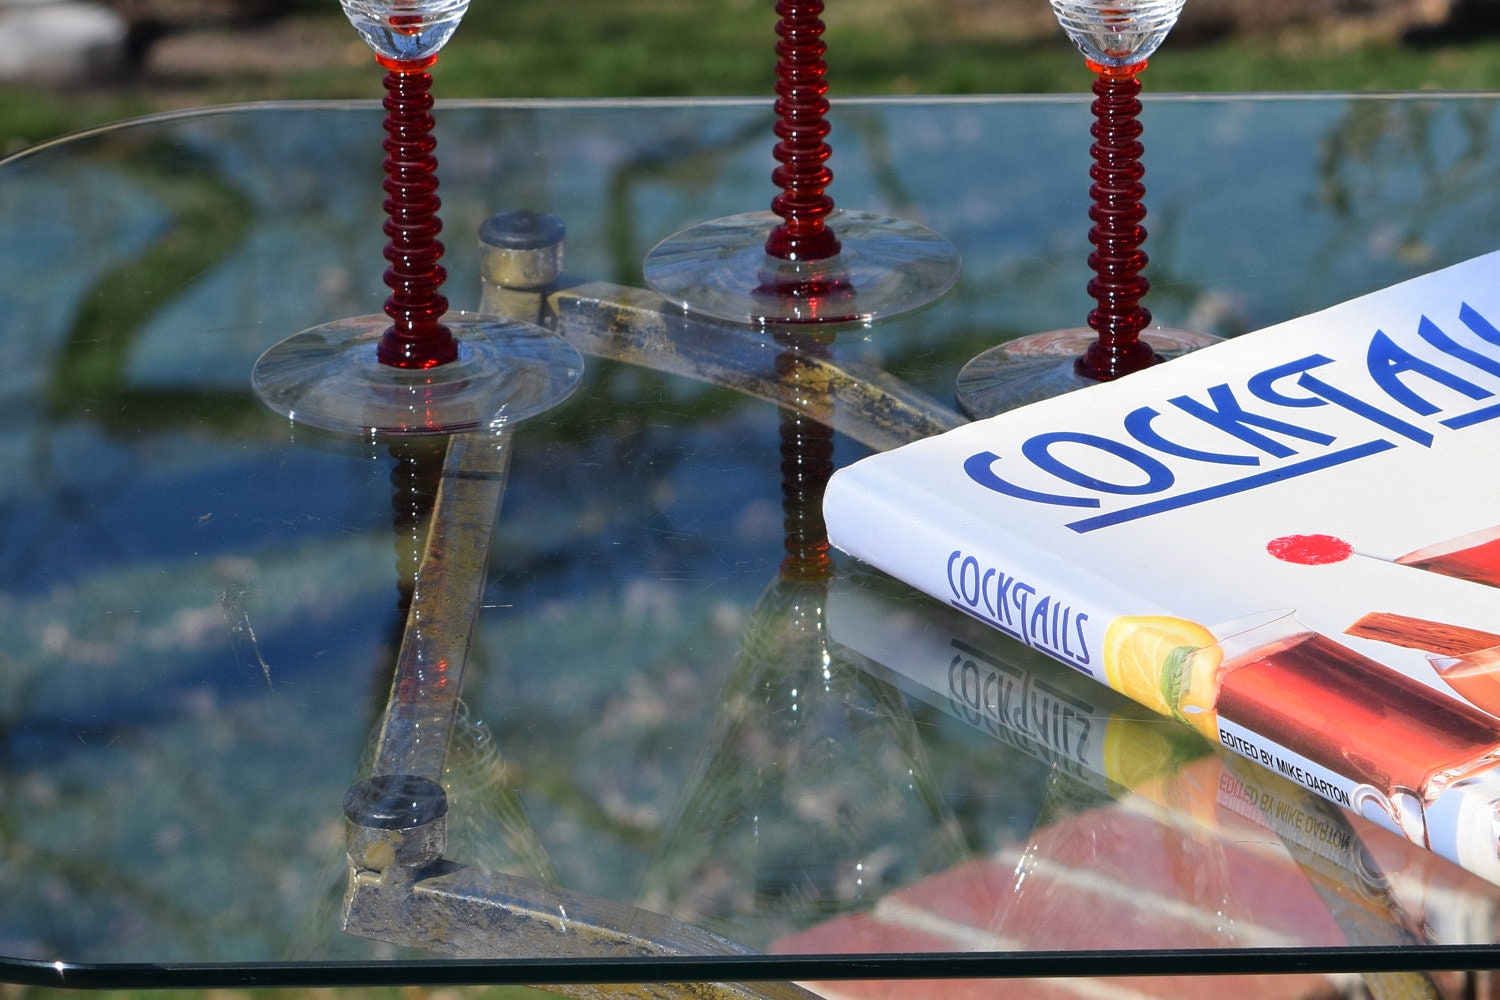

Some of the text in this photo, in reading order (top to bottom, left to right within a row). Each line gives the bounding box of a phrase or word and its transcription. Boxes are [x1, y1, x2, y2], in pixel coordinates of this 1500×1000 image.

[947, 550, 1090, 665] COCKTAILS
[1219, 729, 1351, 807] EDITED BY MIKE DARTON
